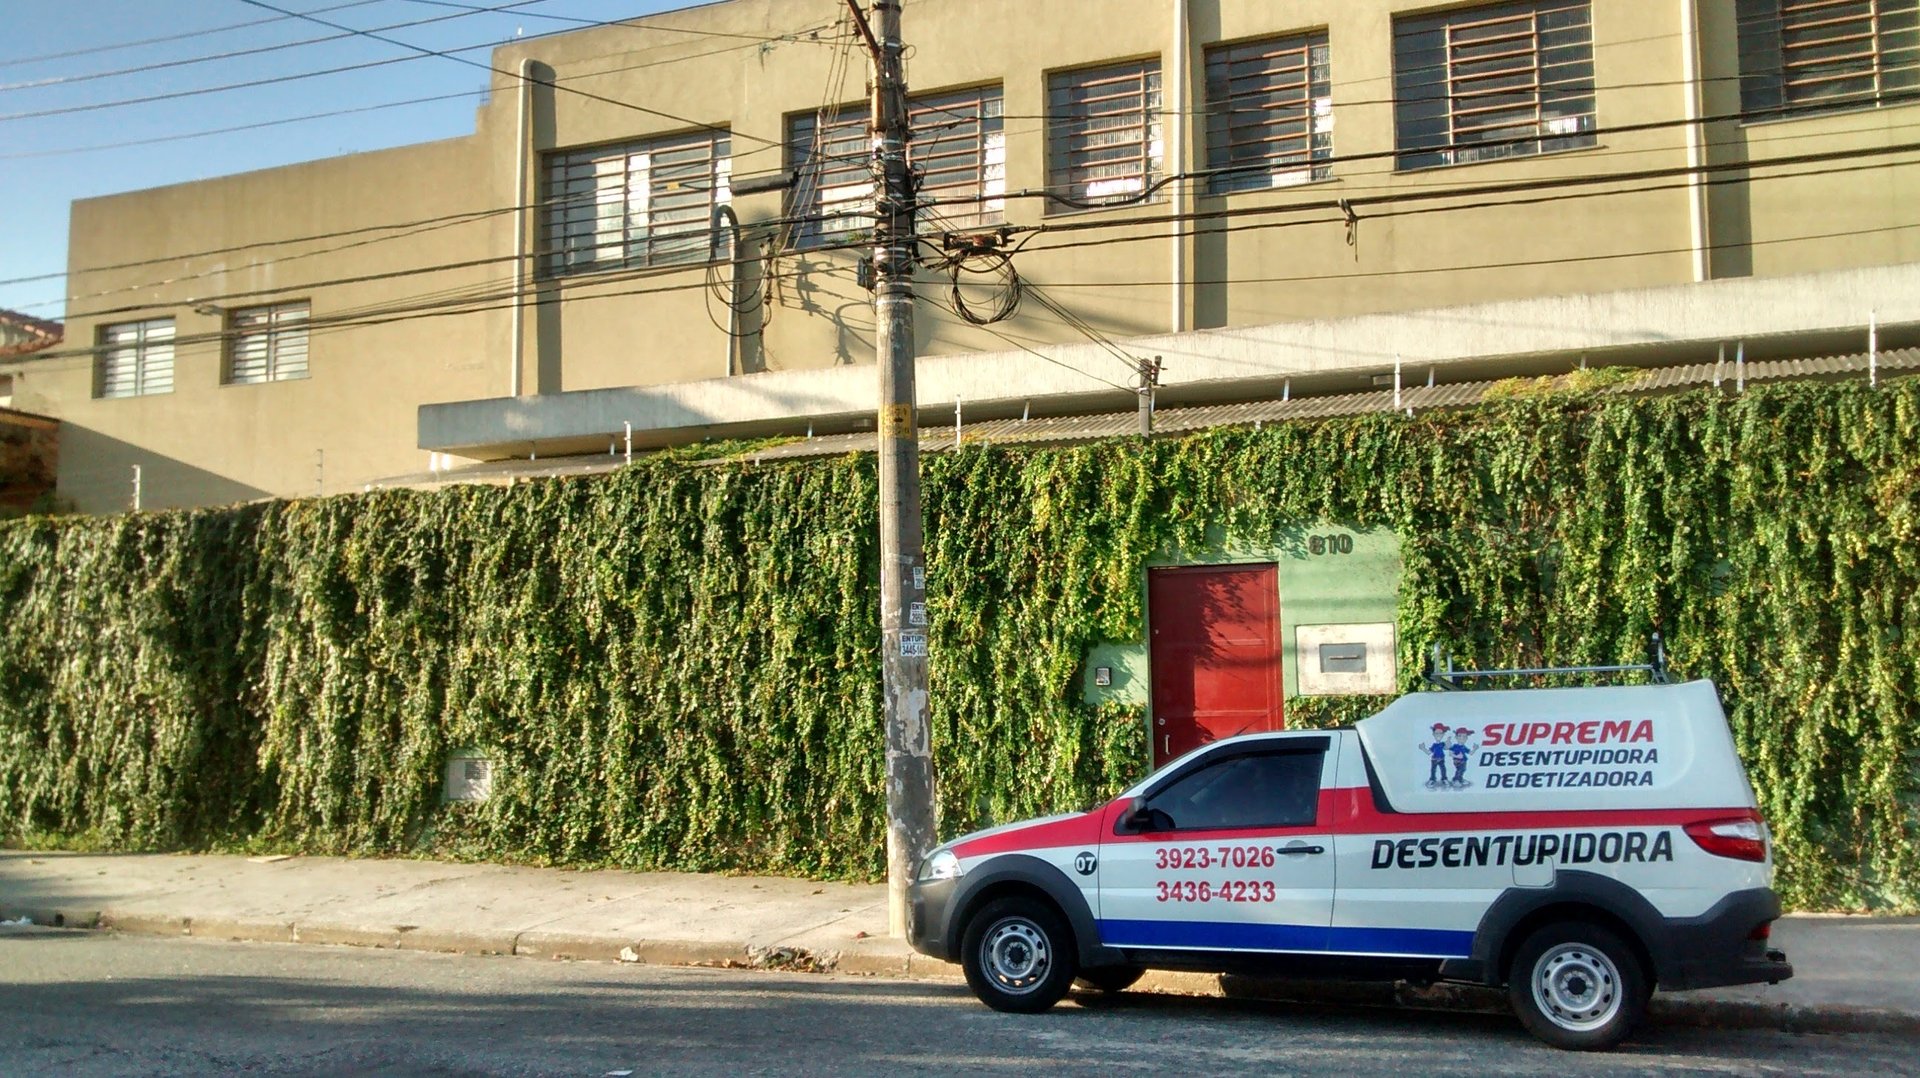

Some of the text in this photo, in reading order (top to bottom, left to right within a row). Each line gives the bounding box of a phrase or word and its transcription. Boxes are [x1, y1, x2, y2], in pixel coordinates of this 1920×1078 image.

[1481, 719, 1655, 747] SUPREMA
[1478, 748, 1659, 768] DESENTUPIDORA
[1485, 770, 1654, 789] DEDETIZADORA
[1155, 846, 1275, 869] 3923-7026
[1371, 830, 1674, 870] DESENTUPIDORA
[1076, 856, 1096, 872] 07
[1156, 880, 1277, 902] 3436-4233
